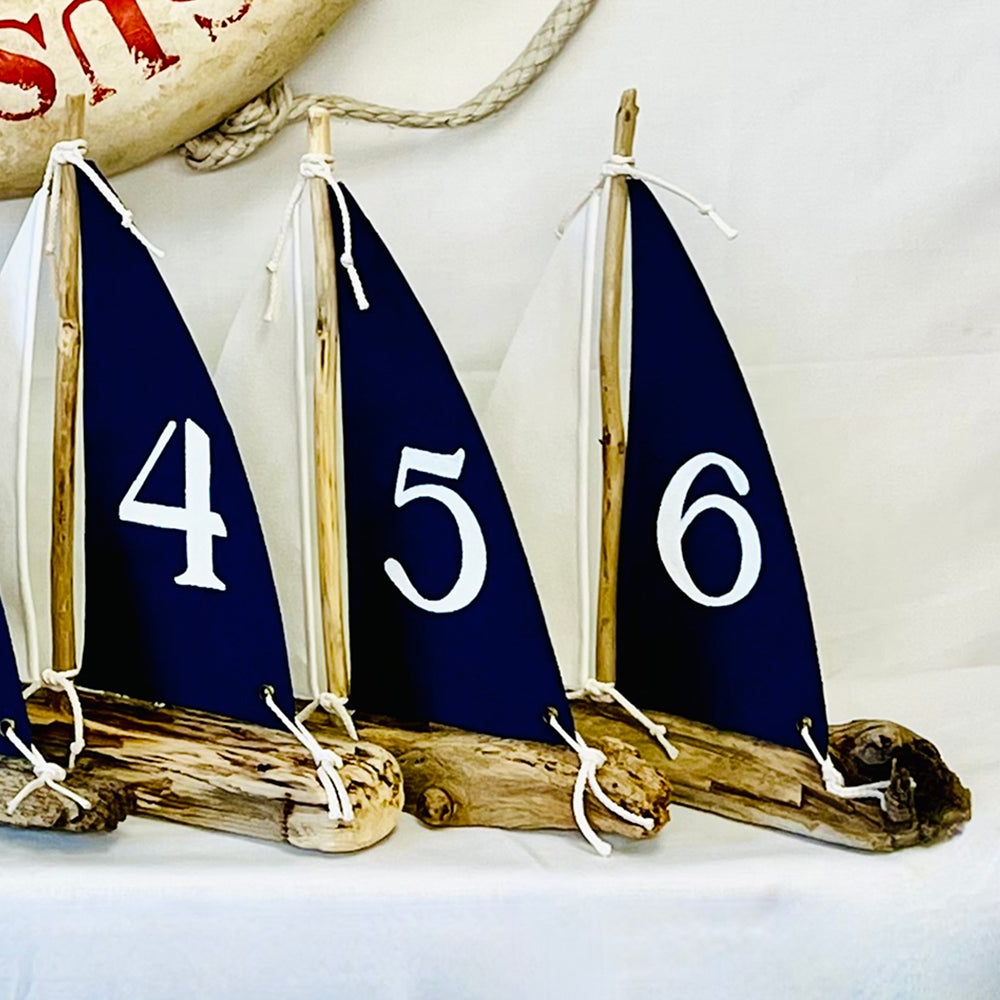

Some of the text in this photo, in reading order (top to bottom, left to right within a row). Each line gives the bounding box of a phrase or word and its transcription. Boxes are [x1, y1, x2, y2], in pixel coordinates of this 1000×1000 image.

[118, 418, 227, 591] 4
[383, 445, 488, 614] 5
[656, 451, 762, 608] 6
